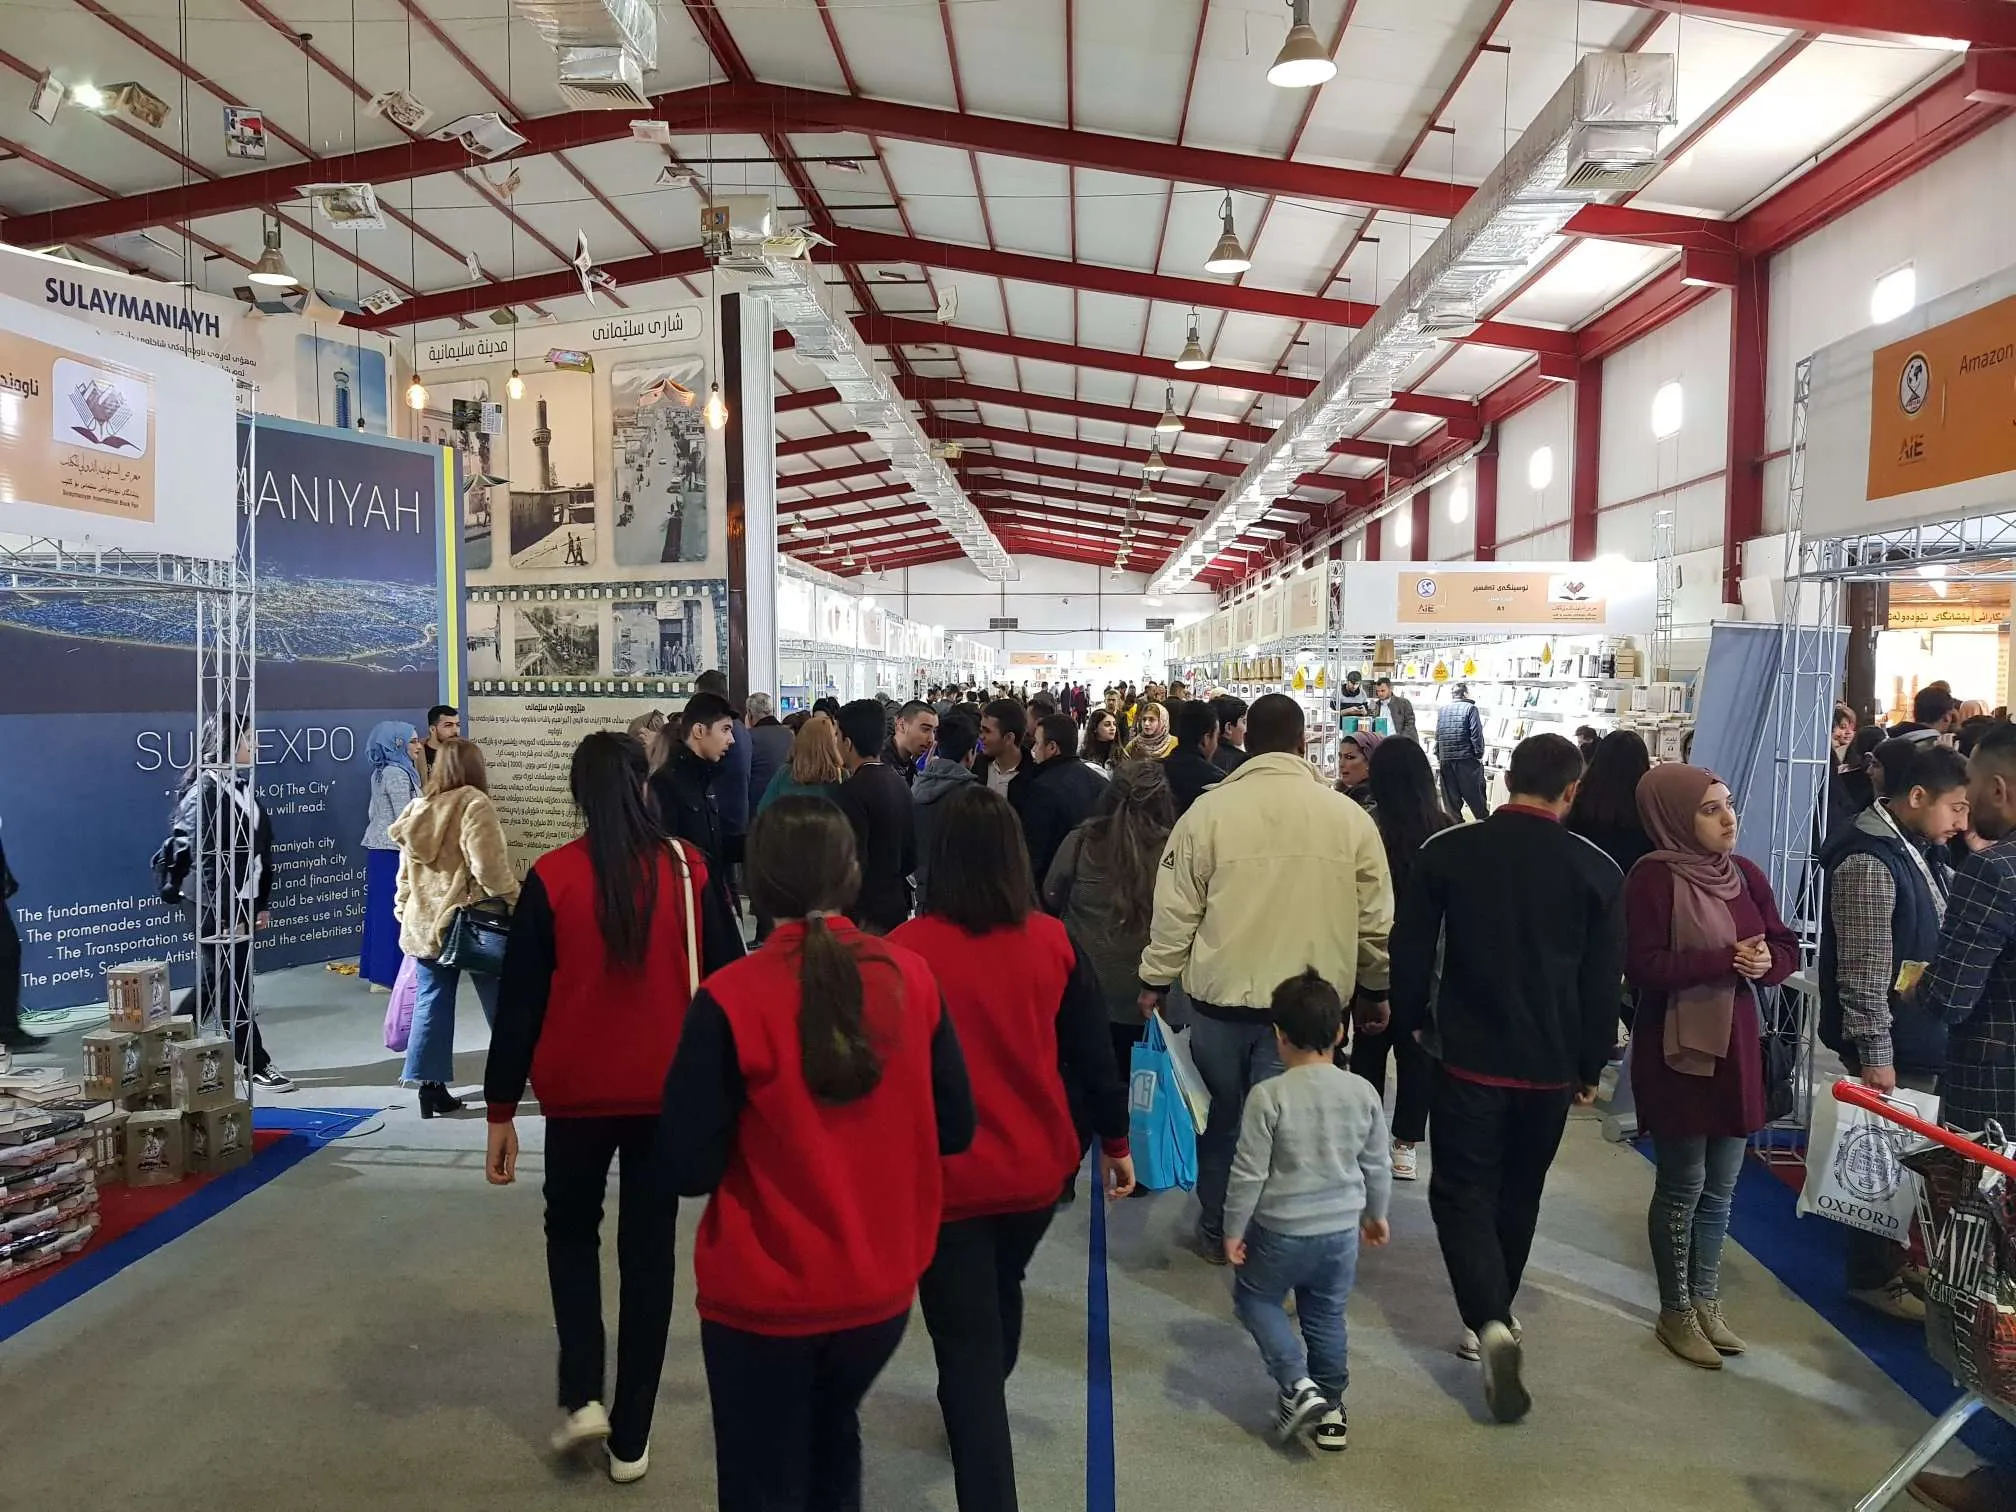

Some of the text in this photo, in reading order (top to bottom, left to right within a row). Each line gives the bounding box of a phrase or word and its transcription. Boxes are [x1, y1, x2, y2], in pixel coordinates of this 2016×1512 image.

[45, 277, 220, 338] SULAYMANIAYH
[429, 339, 508, 364] مدينة سليمانية
[1959, 343, 2014, 375] Amazon
[136, 726, 354, 771] SU EXPO
[269, 784, 283, 798] Of
[287, 783, 305, 796] The
[277, 801, 294, 814] will
[298, 801, 325, 814] read:
[270, 836, 335, 853] maniyah city
[271, 854, 347, 873] aymaniyah city
[271, 867, 367, 890] al and financial of
[300, 893, 313, 905] be
[316, 888, 348, 903] visited
[351, 888, 360, 898] in
[16, 895, 162, 923] The fundamental prin
[312, 911, 331, 921] use
[334, 908, 342, 918] in
[26, 928, 52, 943] The
[57, 917, 141, 942] promenades
[145, 911, 170, 927] and
[174, 909, 186, 922] th
[56, 946, 81, 961] The
[84, 934, 178, 956] Transportation
[182, 932, 195, 942] se
[254, 935, 276, 950] and
[280, 933, 297, 945] the
[300, 927, 353, 942] celebrities
[21, 972, 47, 988] The
[52, 966, 94, 986] poets,
[1818, 1195, 1899, 1229] OXFORD
